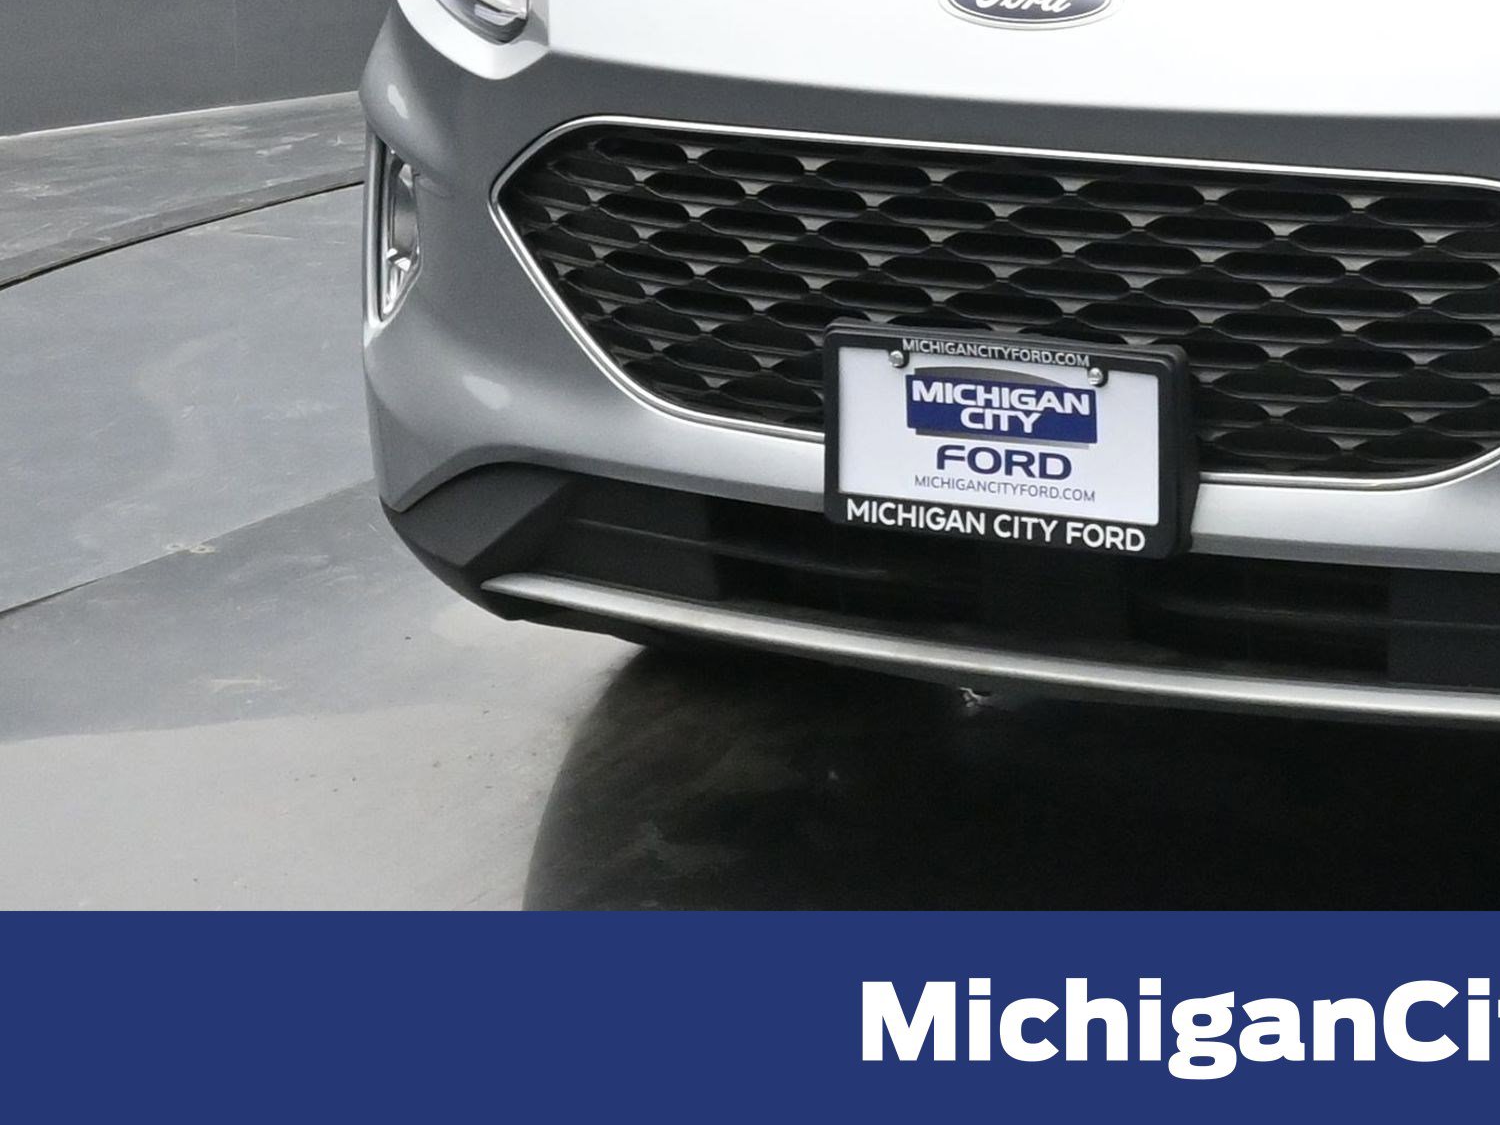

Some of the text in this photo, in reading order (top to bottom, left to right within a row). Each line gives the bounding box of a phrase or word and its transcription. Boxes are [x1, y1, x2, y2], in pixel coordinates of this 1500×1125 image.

[902, 338, 1090, 368] MICHIGANCITYFORD.COM
[911, 379, 1091, 416] MICHIGAN
[960, 407, 1041, 434] CITY
[936, 444, 1073, 481] FORD
[914, 475, 1096, 503] MICHIGANCITYFORD.COM
[847, 498, 1146, 553] MICHIGAN CITY FORD
